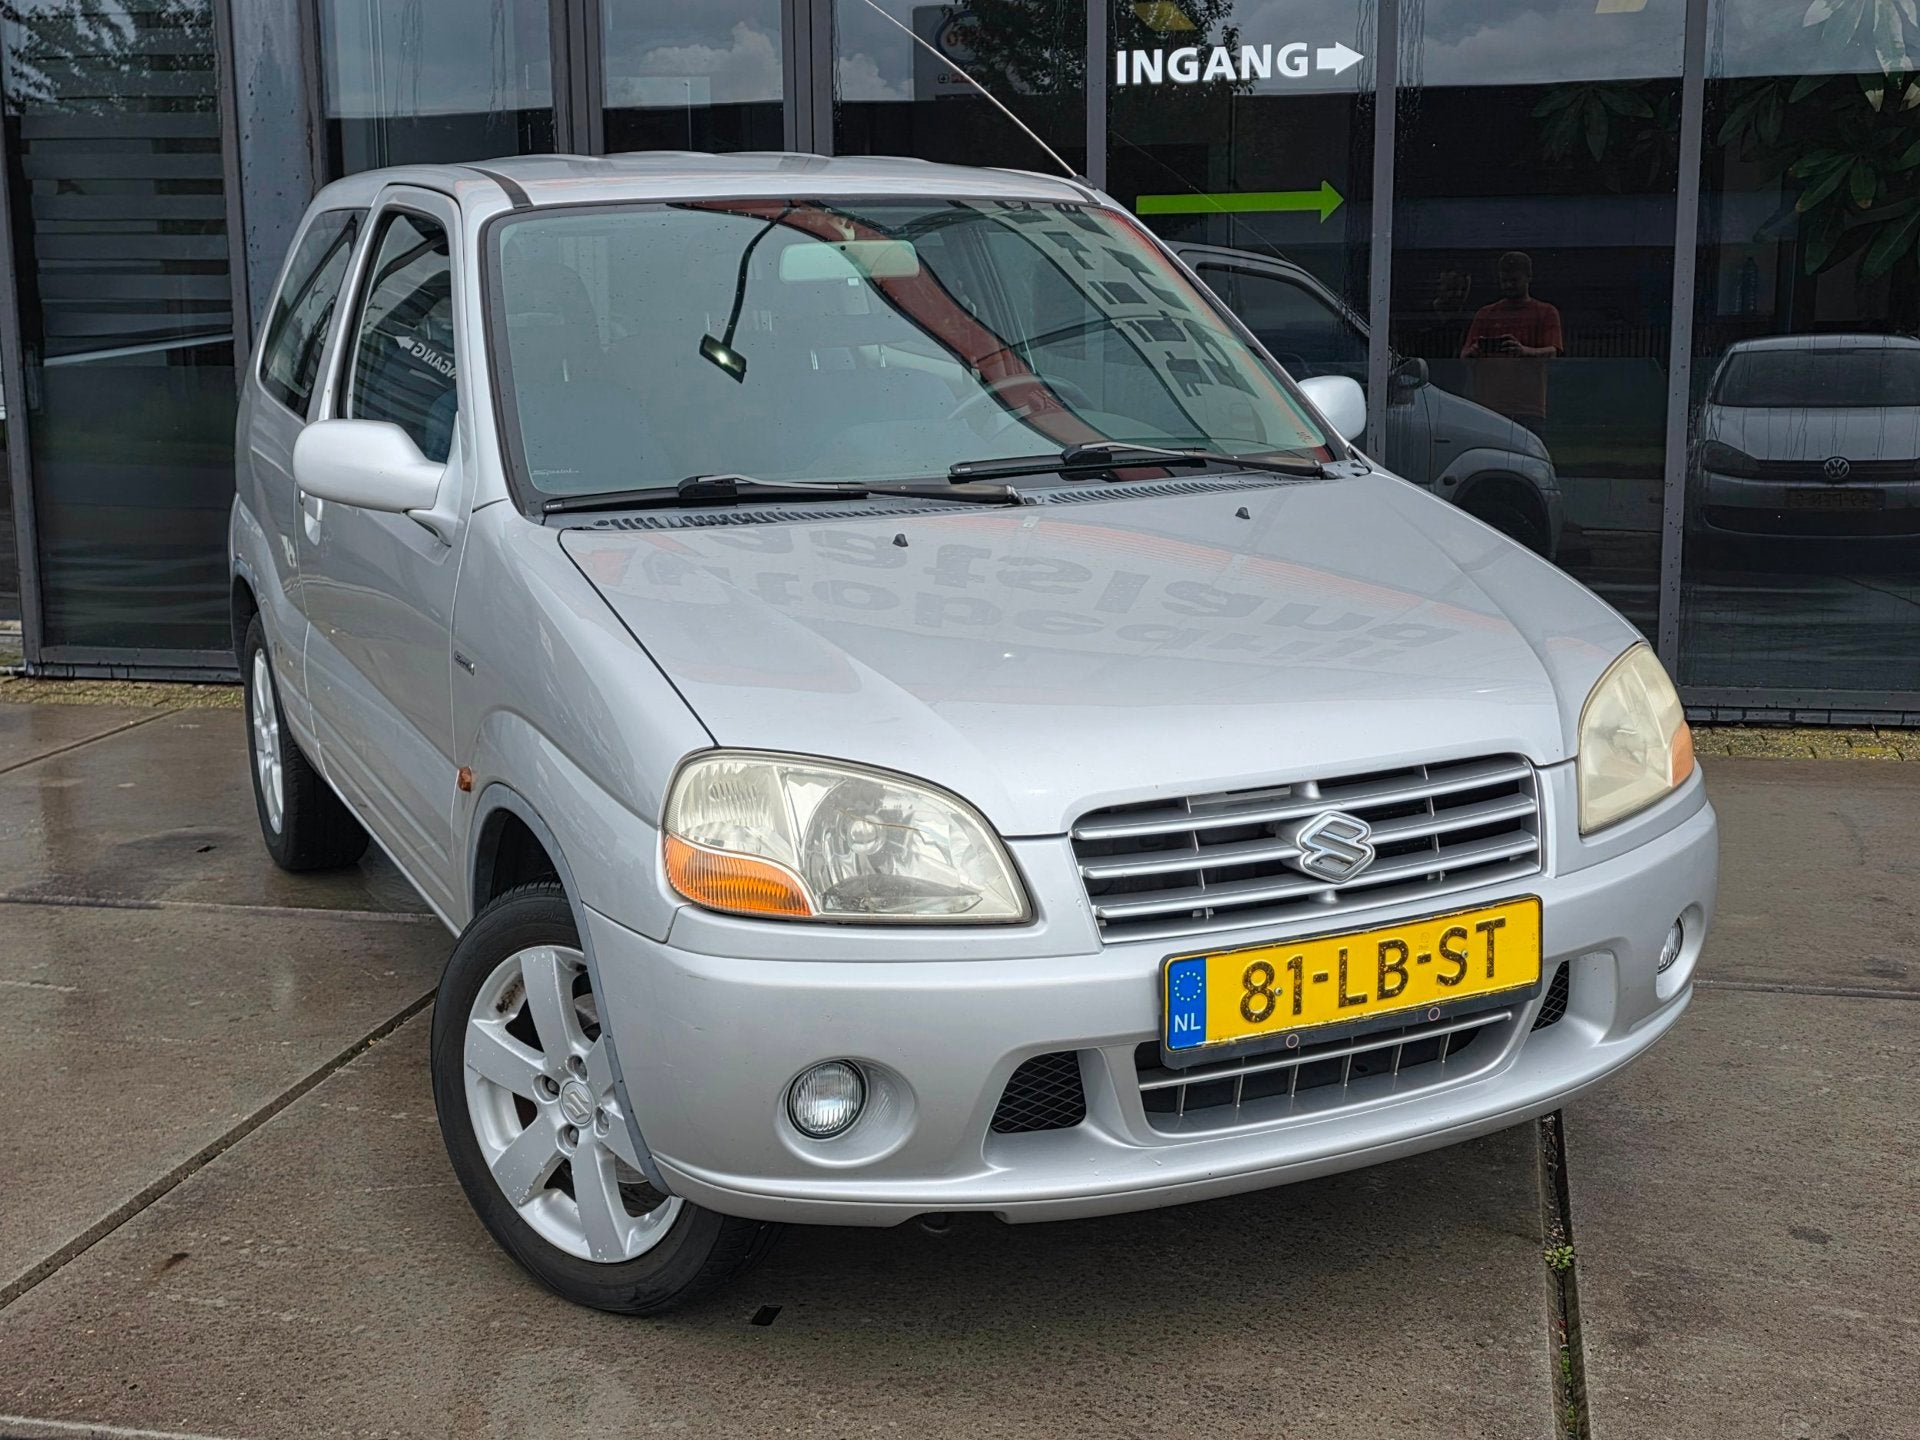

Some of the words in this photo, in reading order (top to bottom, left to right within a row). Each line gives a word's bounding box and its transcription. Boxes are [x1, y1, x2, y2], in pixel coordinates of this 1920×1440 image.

[1117, 43, 1308, 84] INGANG
[1239, 917, 1506, 1024] 81-LB-ST
[1174, 1013, 1202, 1032] NL
